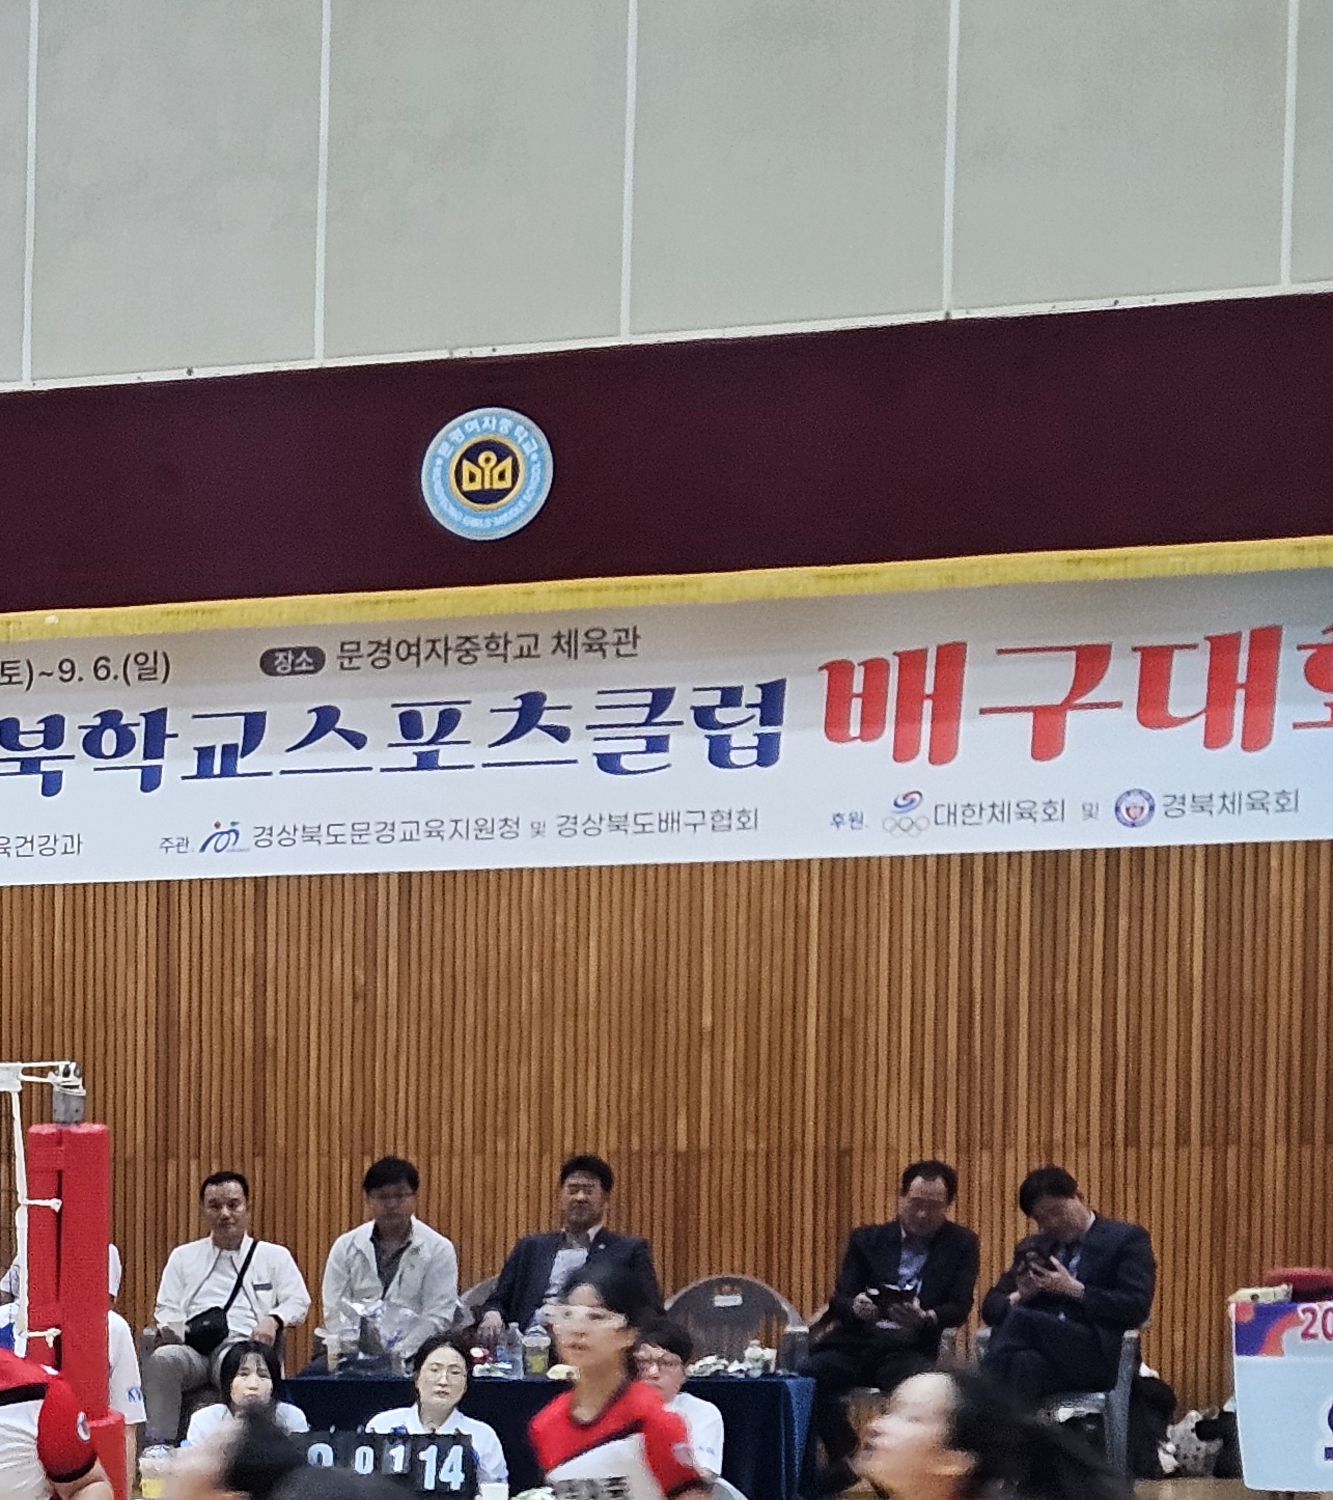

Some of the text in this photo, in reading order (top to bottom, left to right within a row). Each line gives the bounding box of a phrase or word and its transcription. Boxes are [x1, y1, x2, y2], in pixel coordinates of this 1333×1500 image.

[93, 650, 171, 687] 6.(일)
[273, 626, 641, 674] 장소 문경여자중학교 체육관
[159, 806, 759, 855] 주관 경상북도문경교육지원청 및 경상북도배구협회
[831, 812, 865, 831] 후원
[933, 798, 1066, 828] 대한체육회
[1162, 788, 1300, 819] 경북체육회
[419, 1444, 466, 1492] 14
